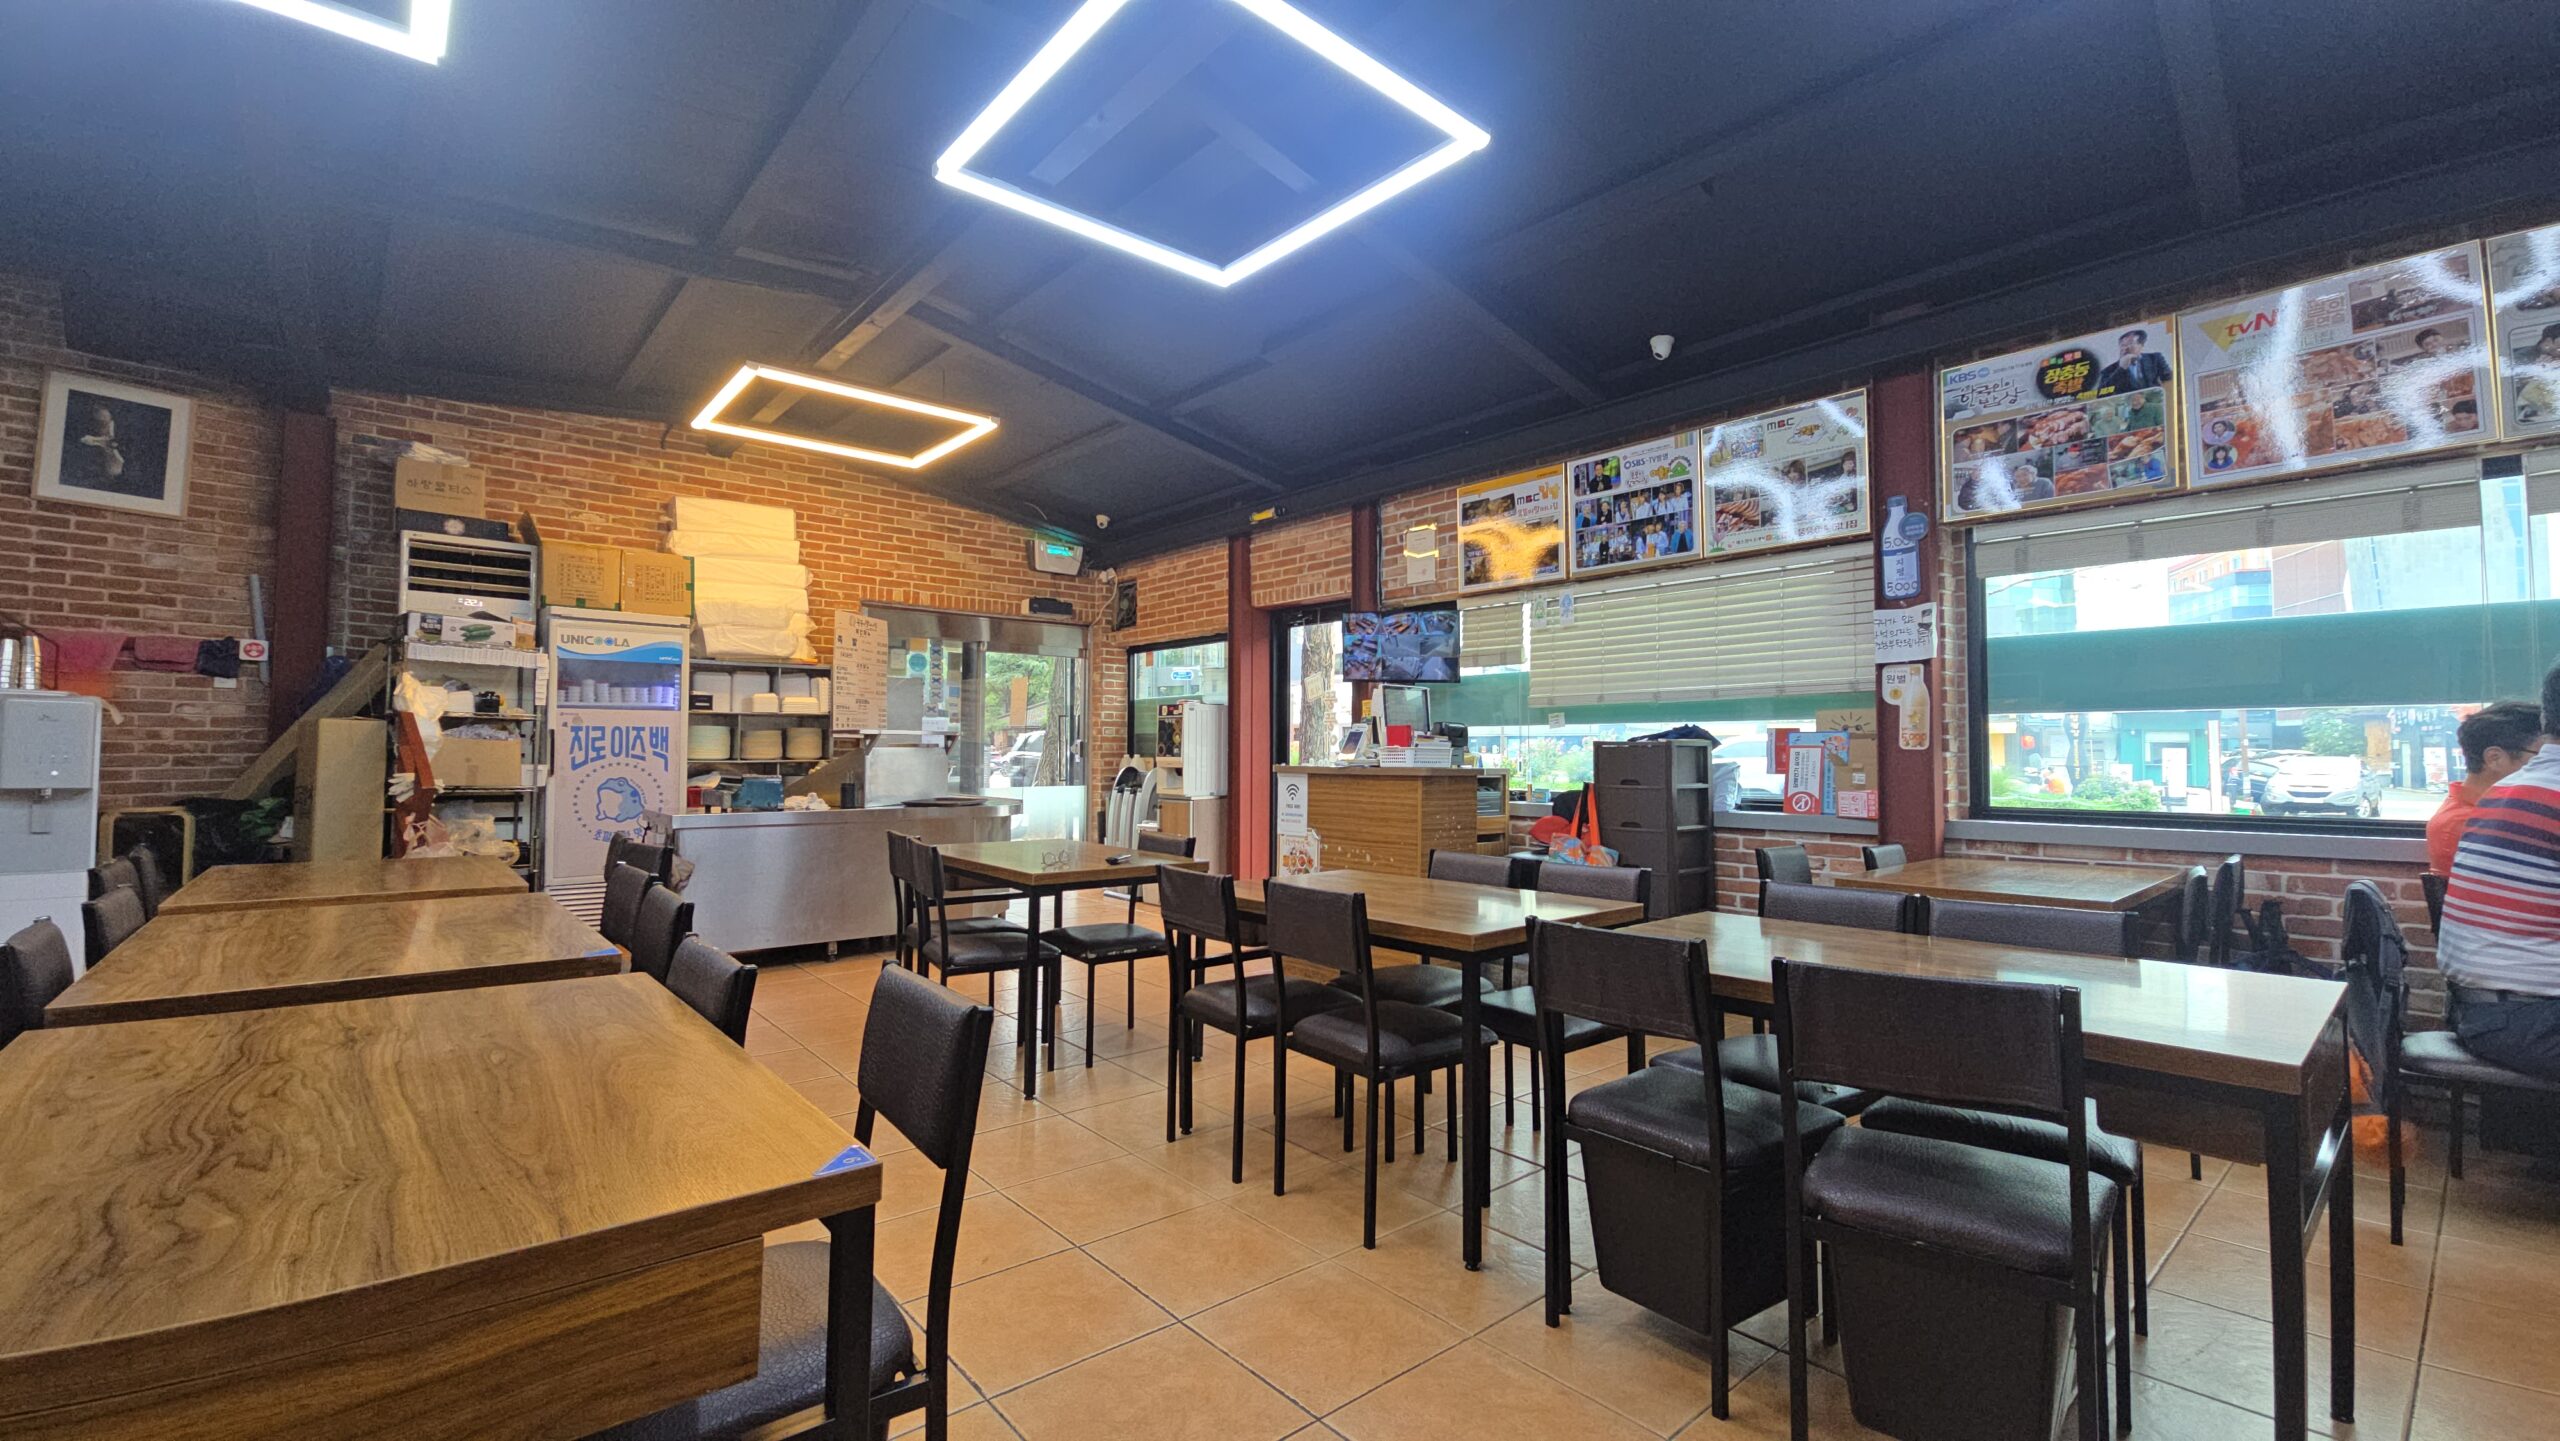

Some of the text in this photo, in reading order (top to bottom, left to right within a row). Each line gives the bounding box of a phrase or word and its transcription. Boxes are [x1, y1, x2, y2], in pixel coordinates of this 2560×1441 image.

[2225, 309, 2278, 337] tvN
[1949, 370, 1977, 385] KBS
[2044, 360, 2091, 385] 장충동
[1766, 417, 1795, 431] MBC
[1516, 492, 1541, 505] MBC
[569, 725, 606, 772] 진로
